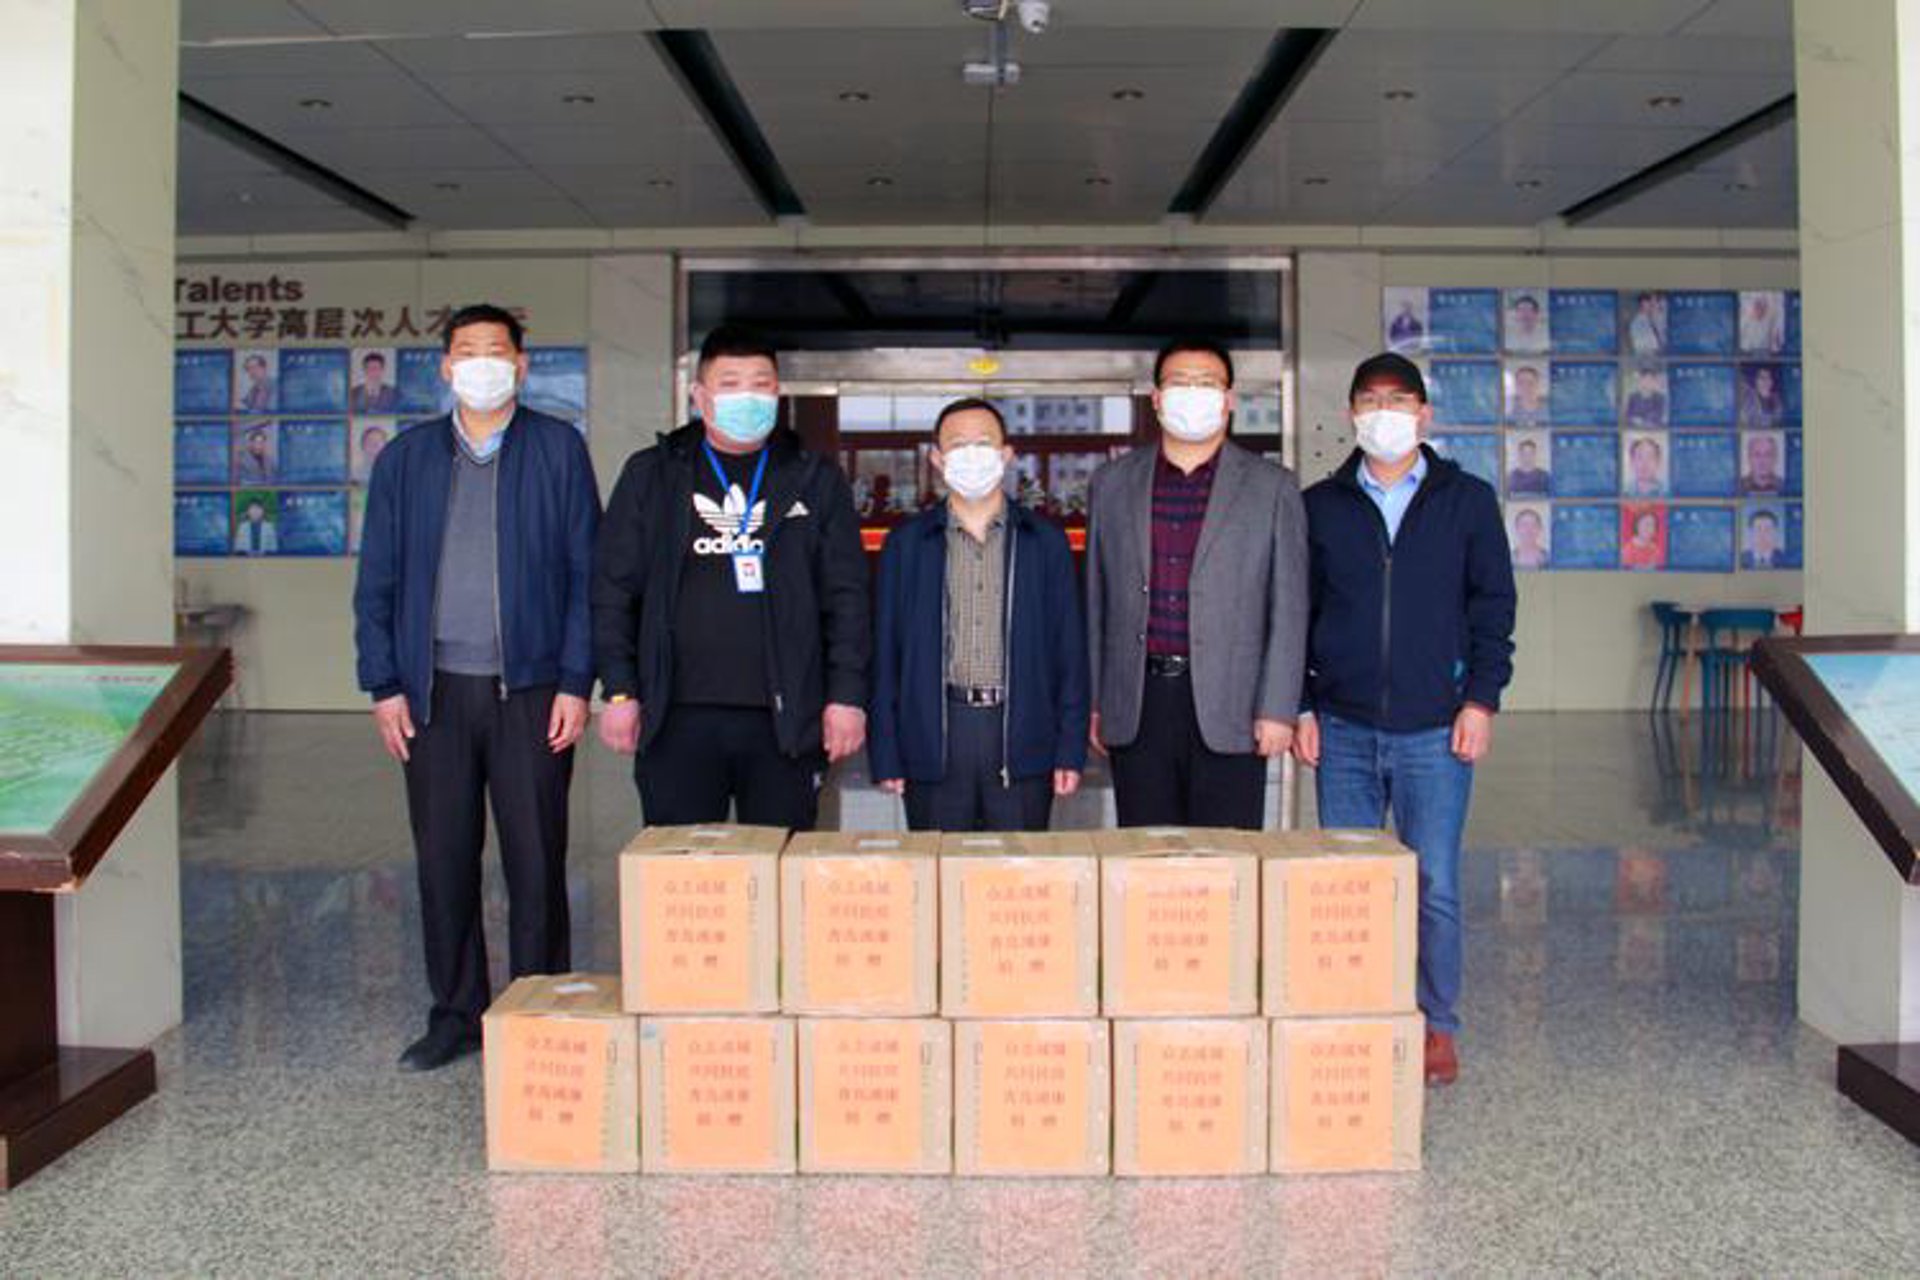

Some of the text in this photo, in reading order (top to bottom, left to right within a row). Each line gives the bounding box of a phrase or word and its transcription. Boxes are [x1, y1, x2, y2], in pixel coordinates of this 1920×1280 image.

[175, 306, 532, 339] 工大学高层次人才
